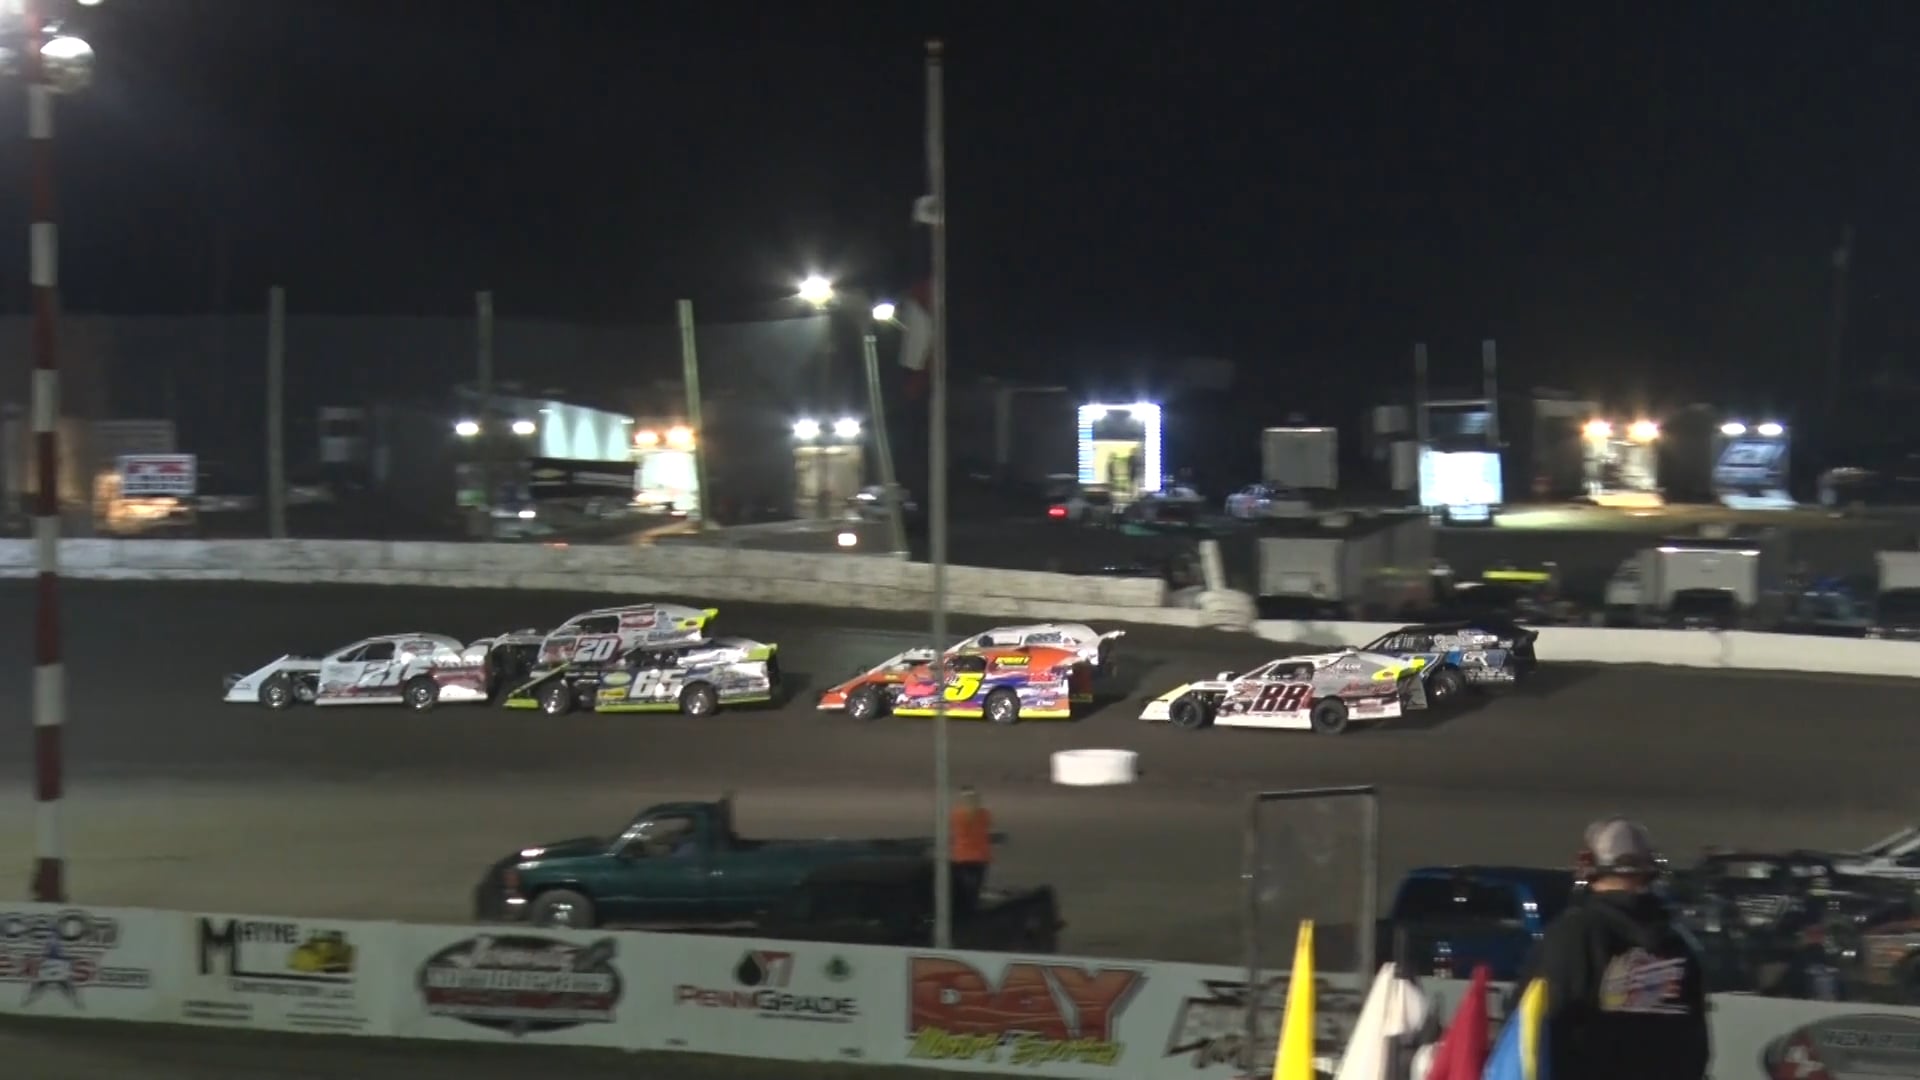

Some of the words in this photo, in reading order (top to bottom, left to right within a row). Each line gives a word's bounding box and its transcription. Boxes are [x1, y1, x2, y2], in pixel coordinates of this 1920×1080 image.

[574, 638, 619, 663] 20
[629, 669, 687, 700] 65
[944, 673, 985, 702] 5
[1253, 683, 1309, 713] 88
